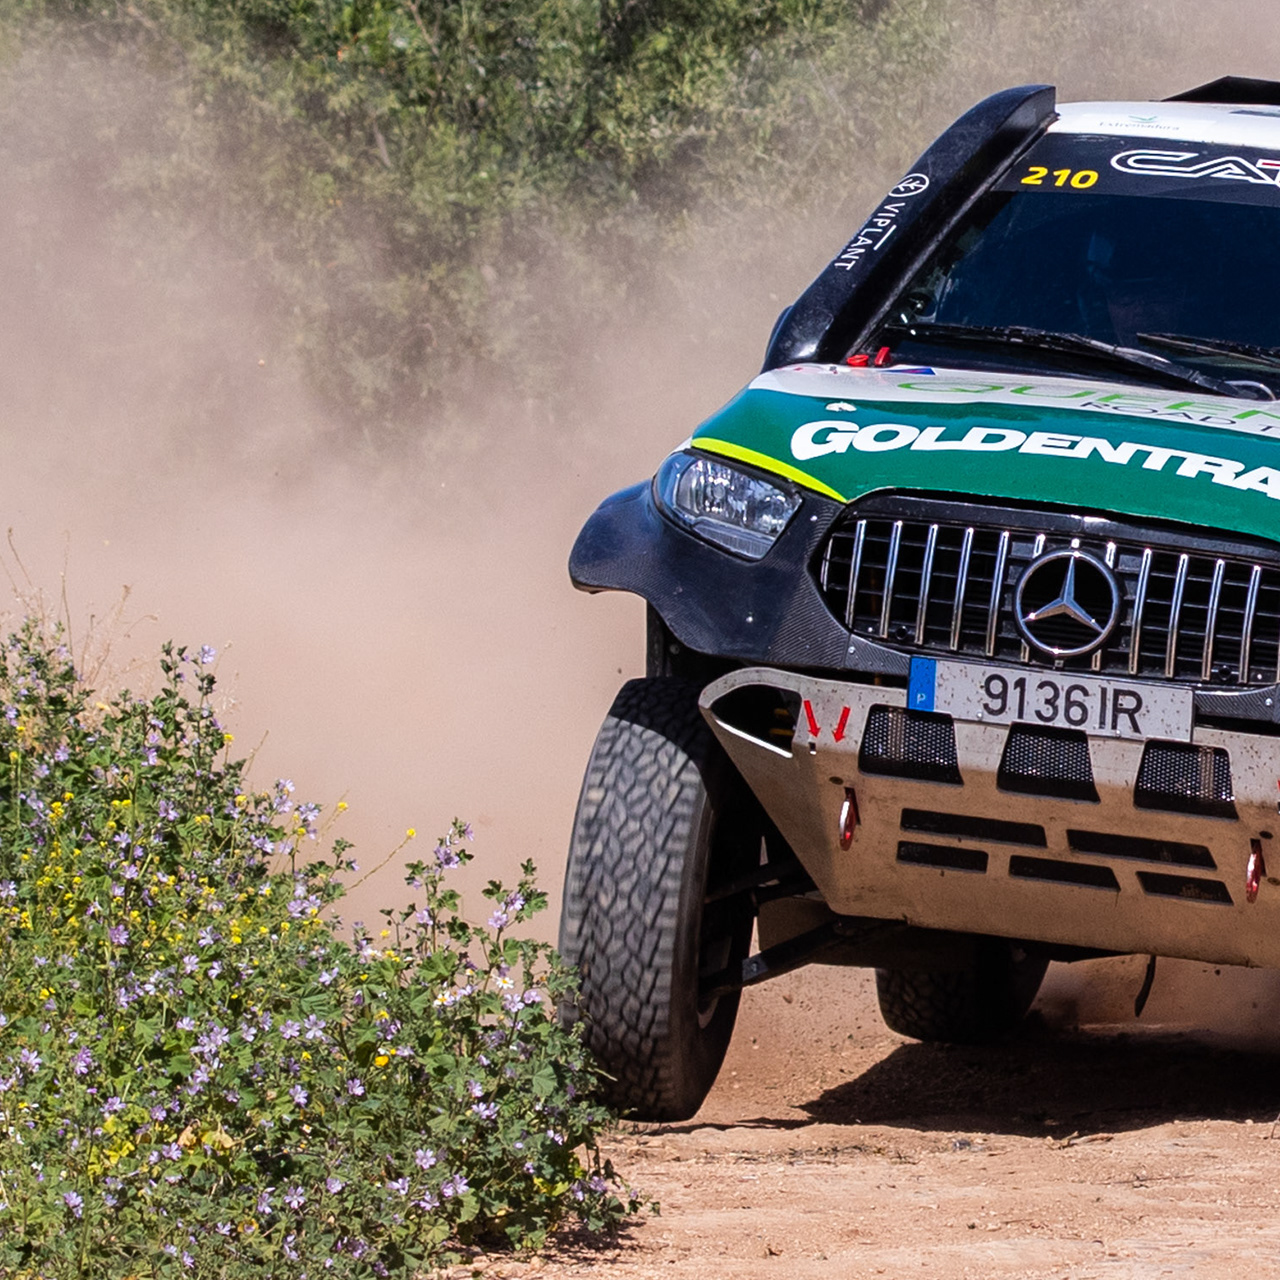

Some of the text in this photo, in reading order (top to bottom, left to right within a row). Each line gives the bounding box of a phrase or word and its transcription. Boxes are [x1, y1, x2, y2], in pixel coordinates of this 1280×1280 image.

[1021, 166, 1099, 189] 210
[834, 202, 905, 270] VIPLANT
[1080, 401, 1236, 426] ROAD
